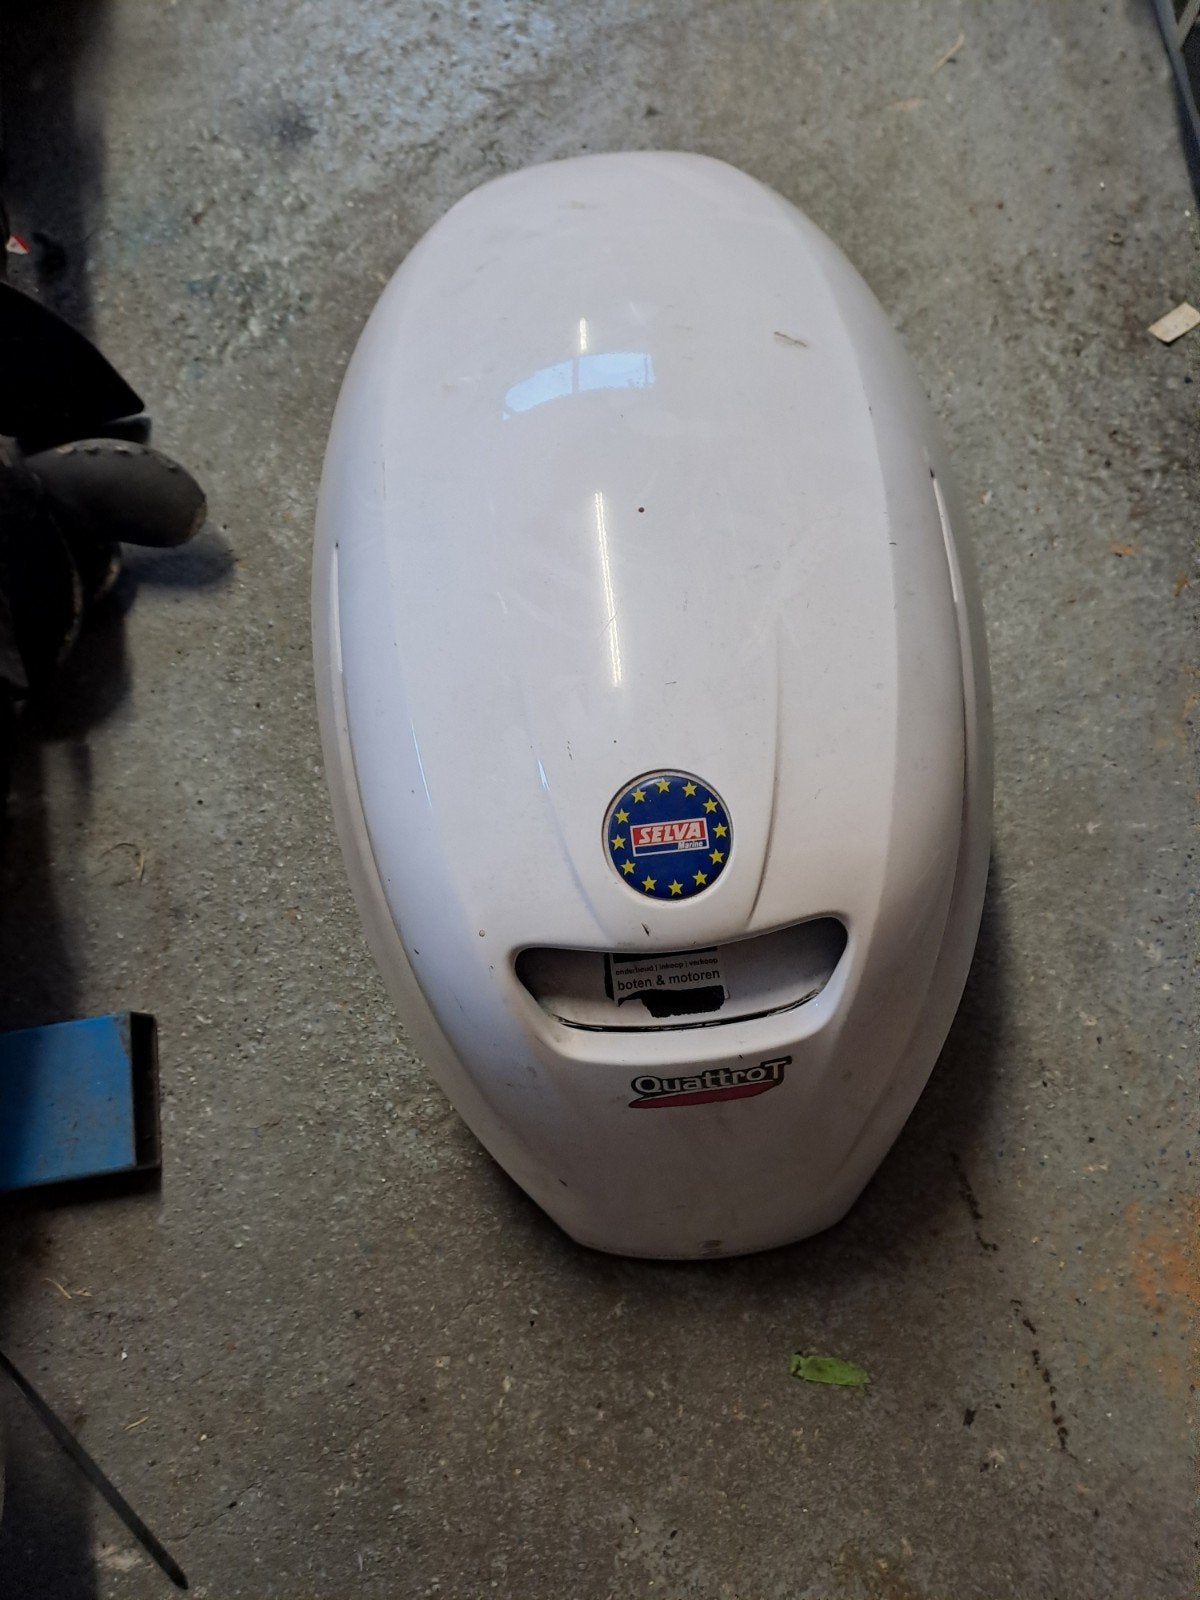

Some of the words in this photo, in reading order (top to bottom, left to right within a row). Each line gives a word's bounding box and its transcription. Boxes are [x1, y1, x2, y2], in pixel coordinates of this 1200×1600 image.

[639, 822, 702, 844] SELVA
[678, 841, 704, 850] Marine
[615, 965, 654, 976] onderhoud
[660, 961, 684, 971] inkoop
[689, 957, 718, 967] verkoop
[617, 978, 652, 991] boten
[656, 974, 666, 986] &
[668, 970, 720, 986] motoren
[634, 1060, 788, 1094] QuattroT
